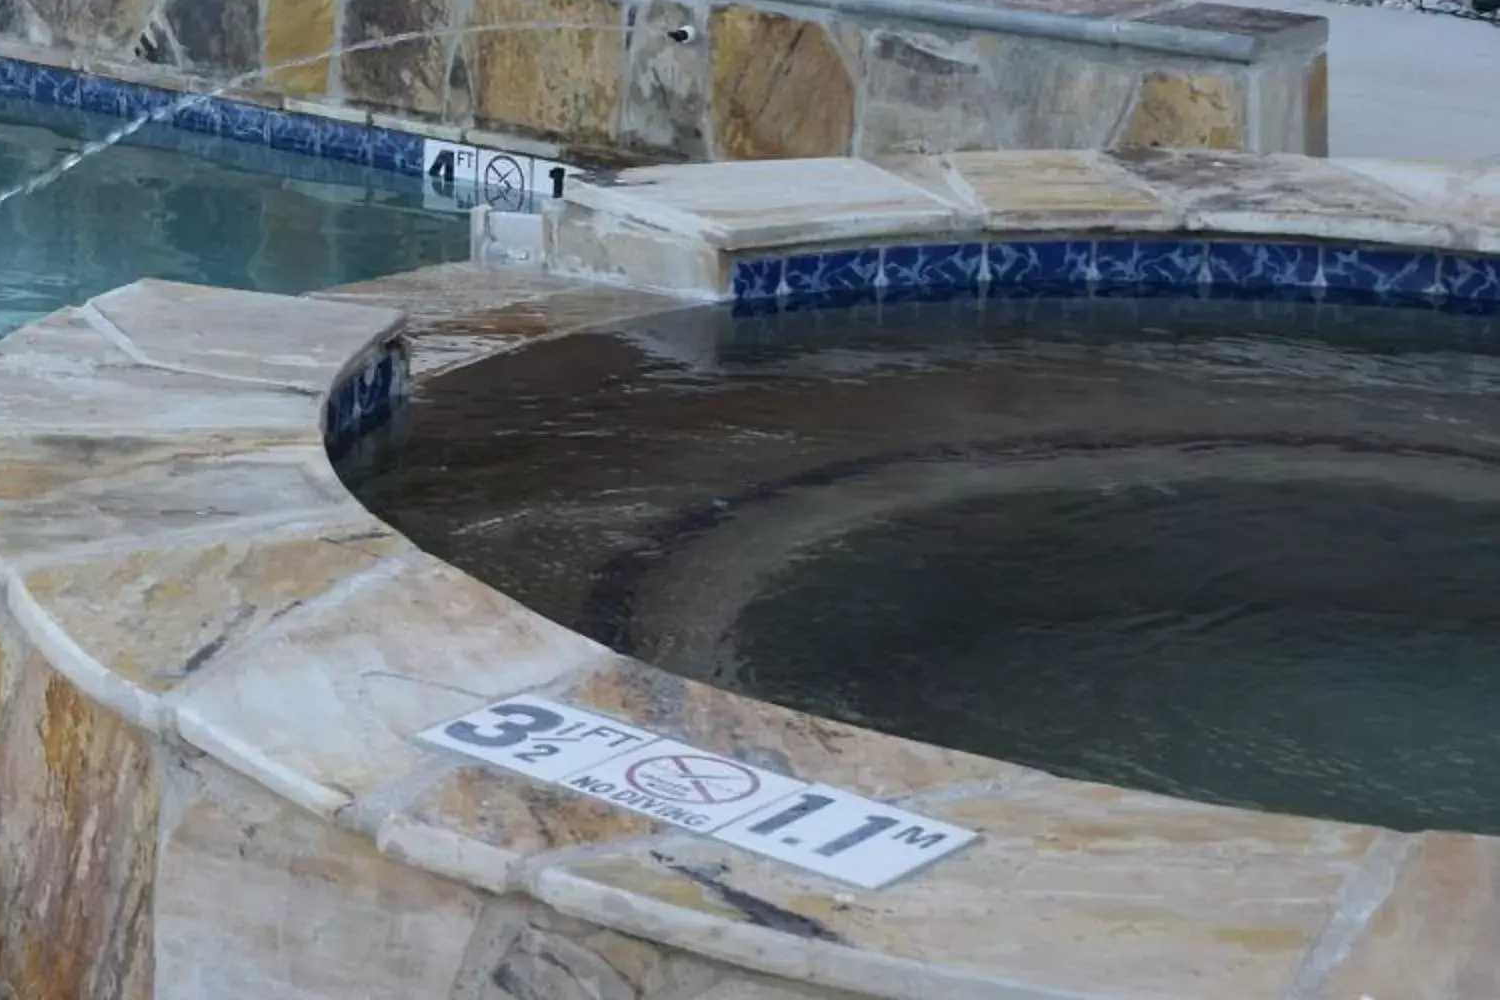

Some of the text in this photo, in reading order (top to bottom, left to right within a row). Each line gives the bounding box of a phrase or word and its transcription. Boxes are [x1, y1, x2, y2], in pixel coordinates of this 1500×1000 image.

[457, 151, 475, 168] FT
[581, 725, 644, 747] FT
[570, 775, 712, 827] NO DIVING
